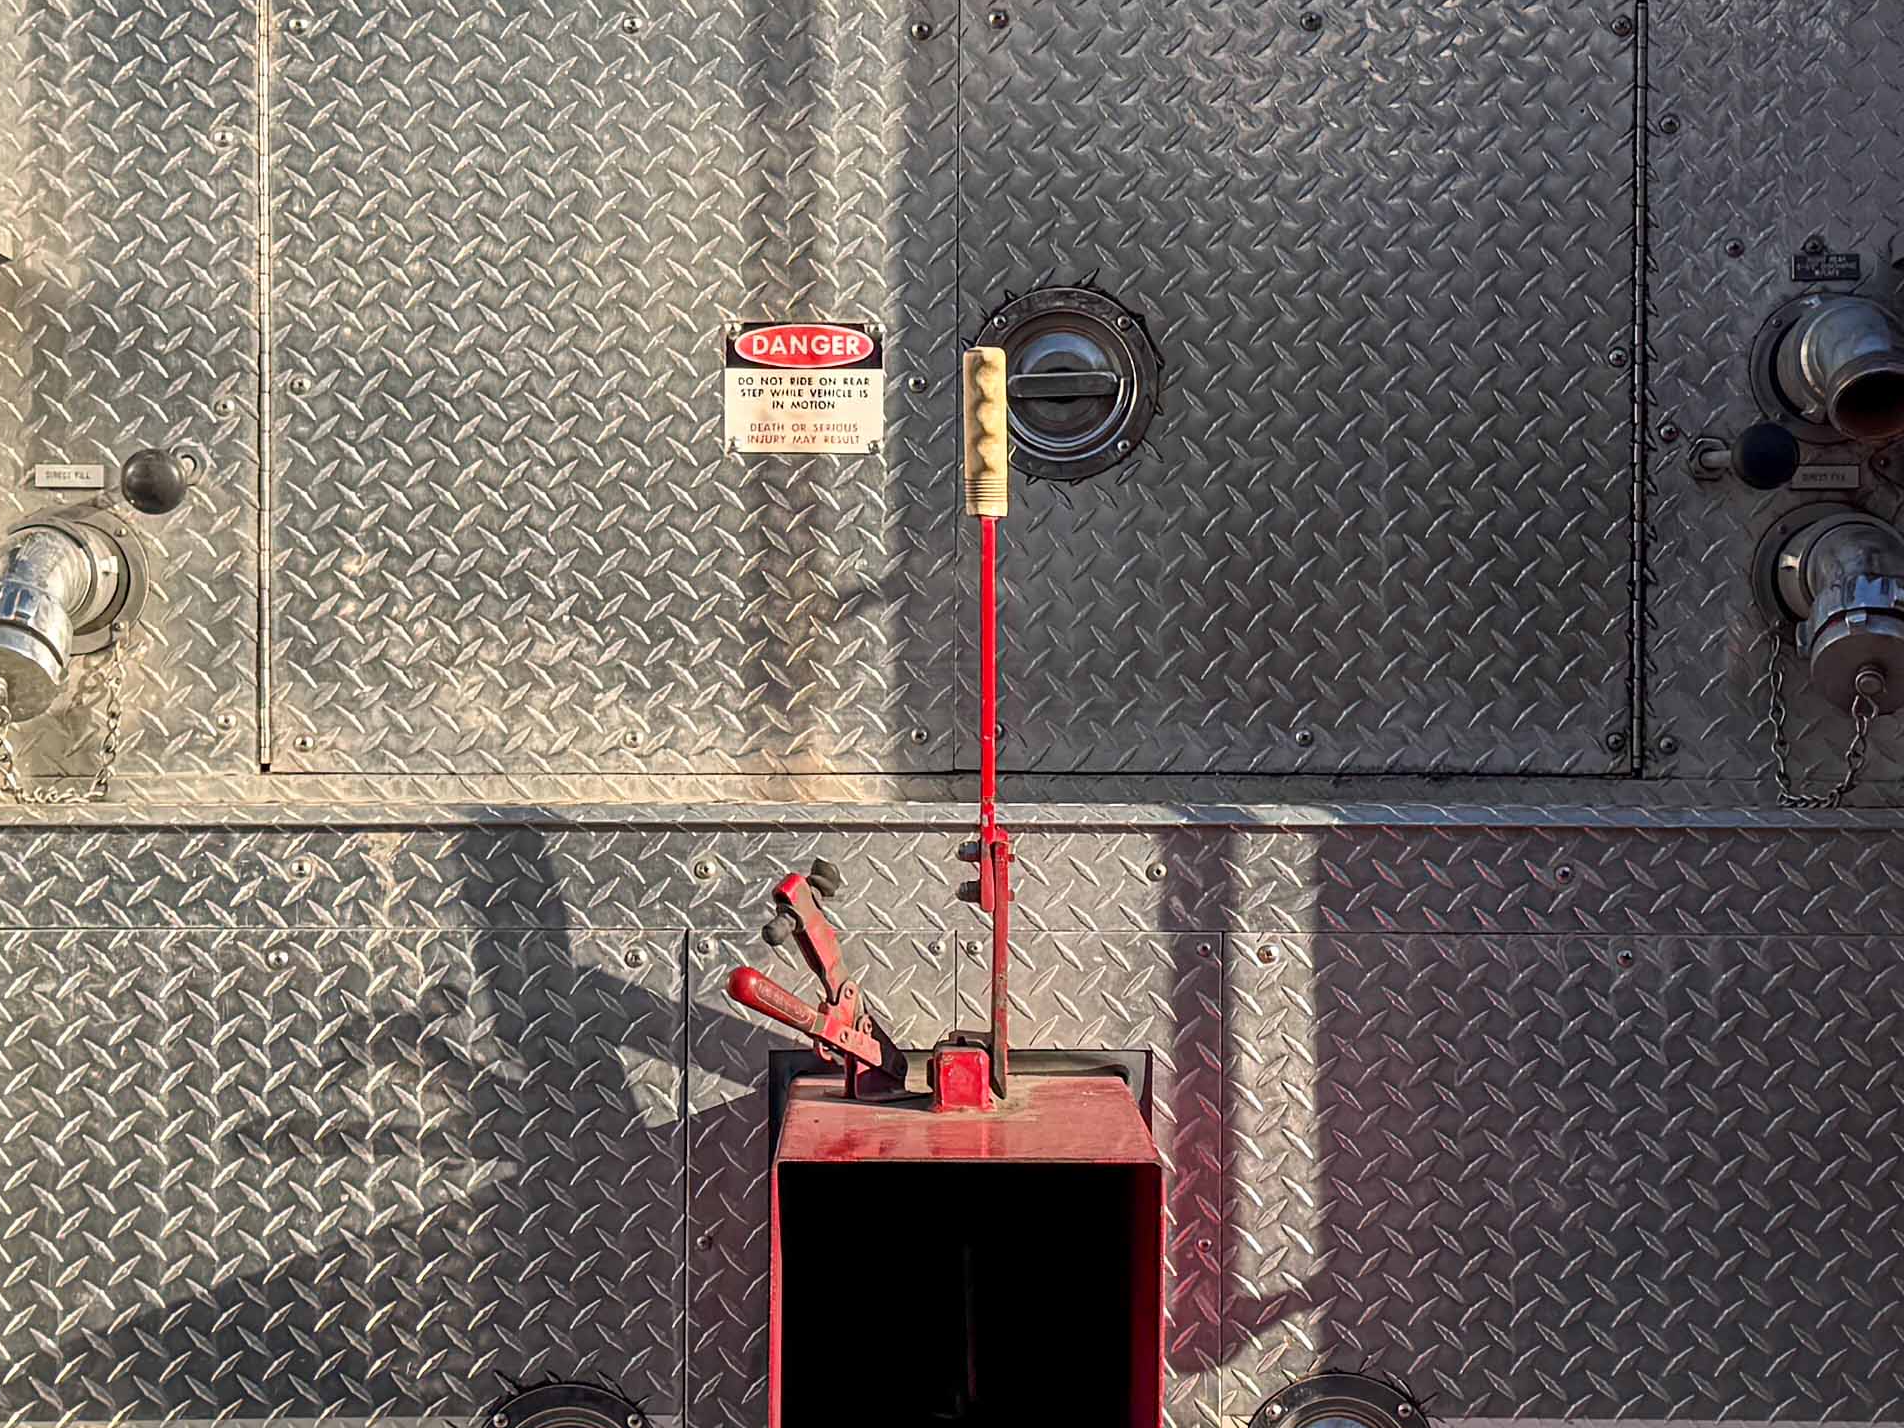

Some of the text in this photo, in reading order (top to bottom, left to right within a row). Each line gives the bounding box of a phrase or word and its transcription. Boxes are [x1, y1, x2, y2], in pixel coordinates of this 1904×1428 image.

[752, 335, 861, 356] DANGER
[738, 377, 870, 386] DO NOT RIDE ON REAR
[740, 389, 868, 398] STEP WHILE VEHICLE IS
[772, 400, 835, 410] IN MOTION
[750, 423, 858, 433] DEATH OR SERIOUS
[747, 435, 860, 444] INJURY MAY RESULT
